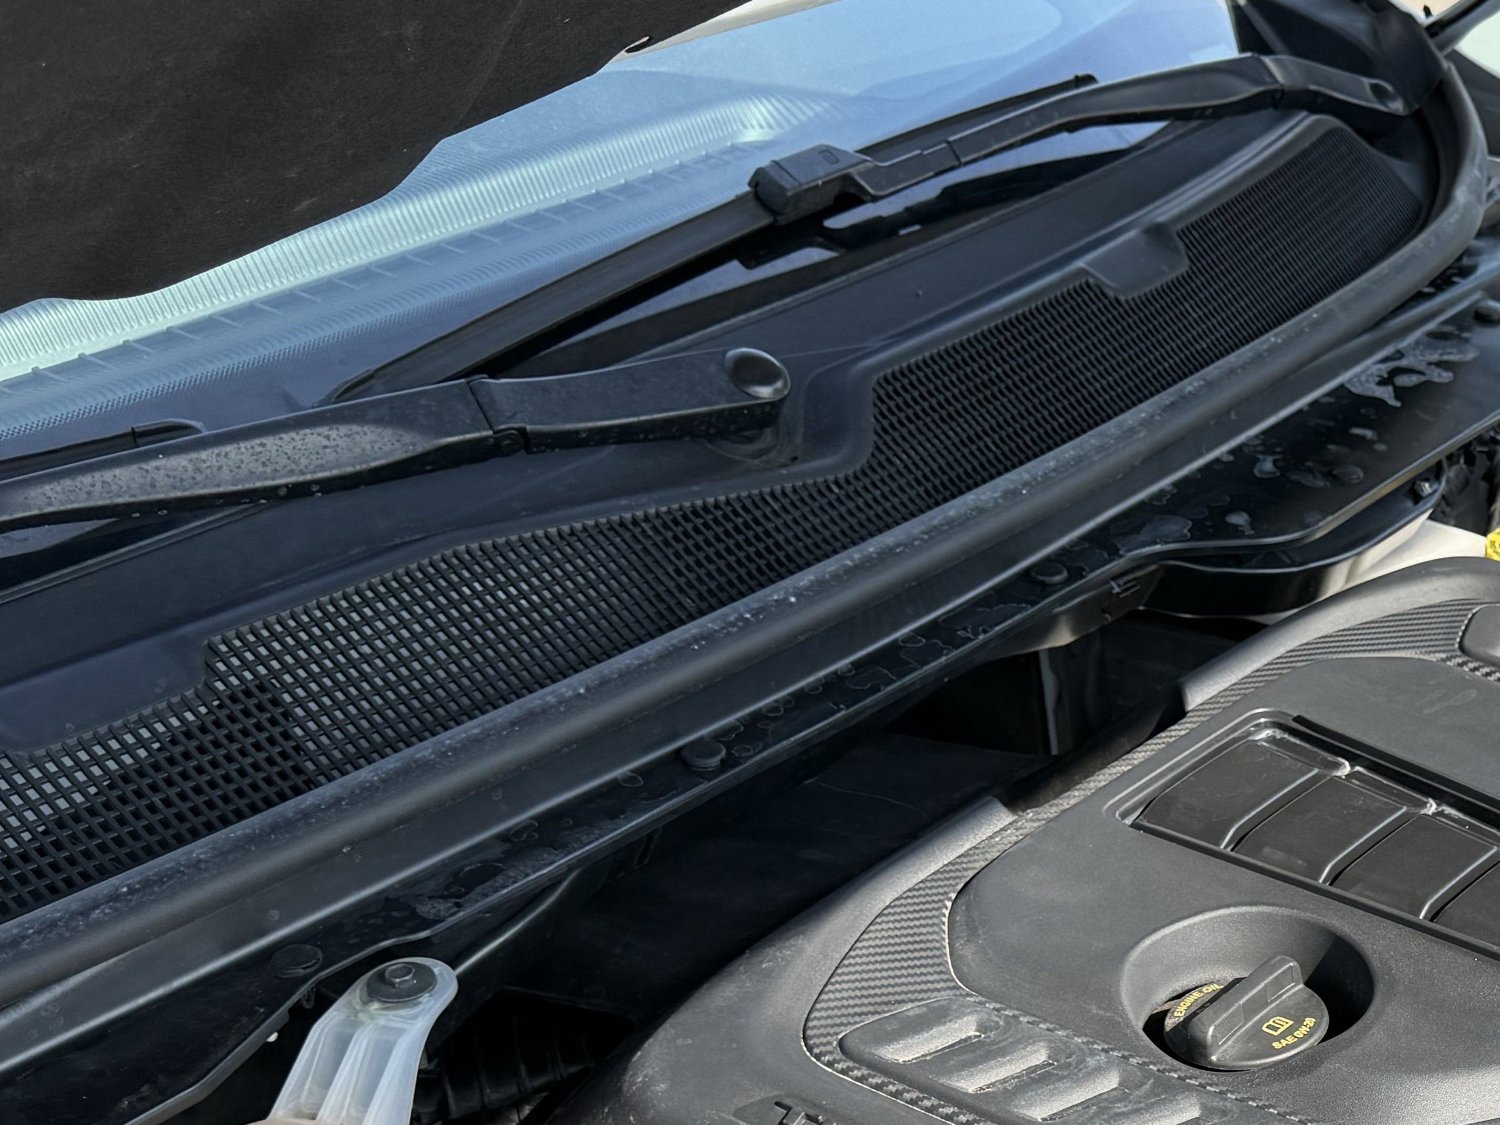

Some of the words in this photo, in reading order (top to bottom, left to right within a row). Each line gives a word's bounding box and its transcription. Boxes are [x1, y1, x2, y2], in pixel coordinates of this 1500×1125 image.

[1174, 991, 1204, 1018] ENGINE
[1203, 983, 1224, 994] OIL
[1271, 1035, 1297, 1050] SAE
